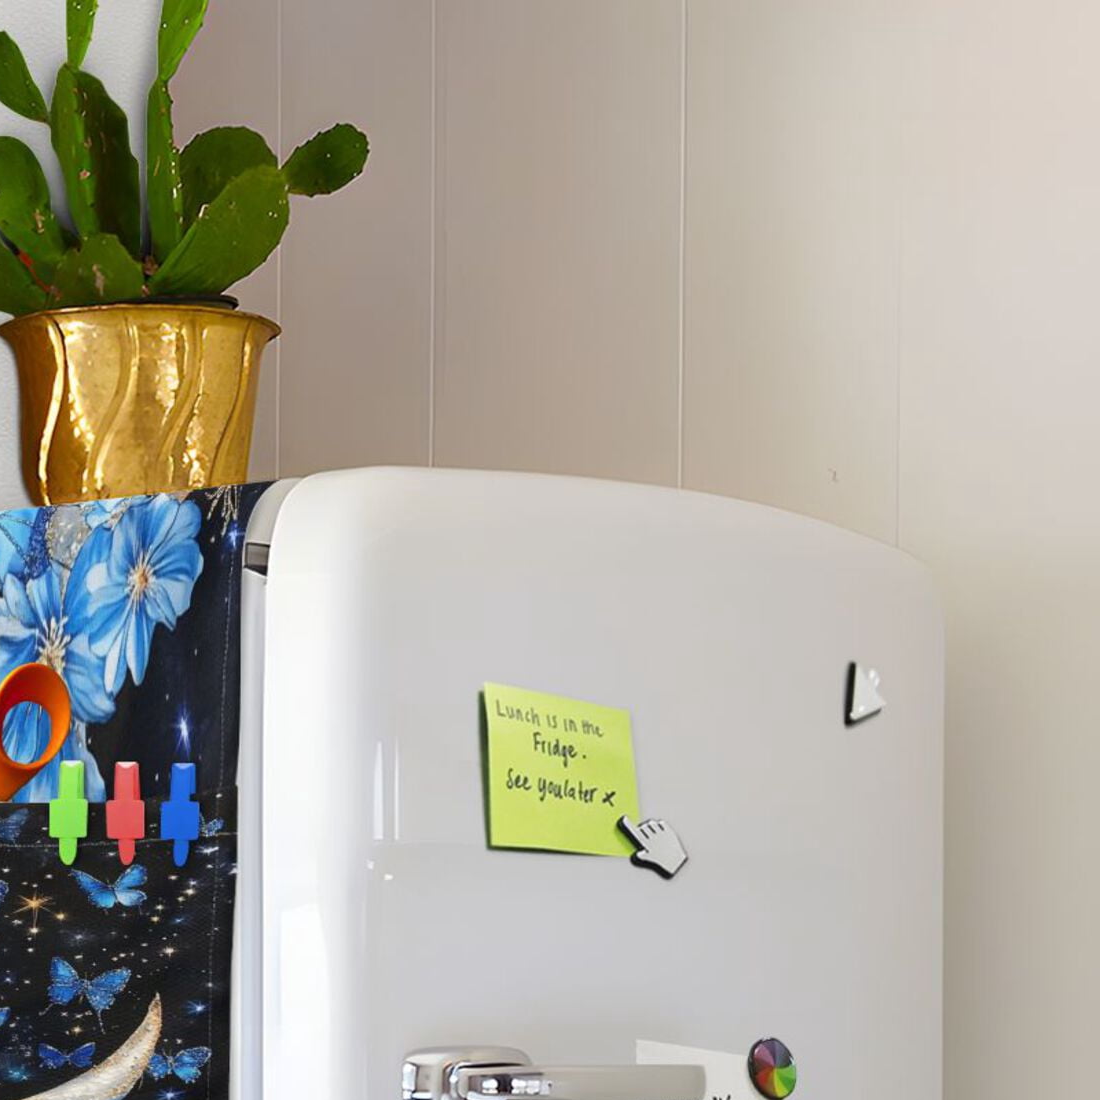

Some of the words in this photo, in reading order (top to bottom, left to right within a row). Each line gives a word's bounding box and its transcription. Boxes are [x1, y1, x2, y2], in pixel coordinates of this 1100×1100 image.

[495, 699, 540, 728] Lunch
[563, 717, 578, 733] in
[581, 719, 604, 738] the
[506, 768, 532, 790] See
